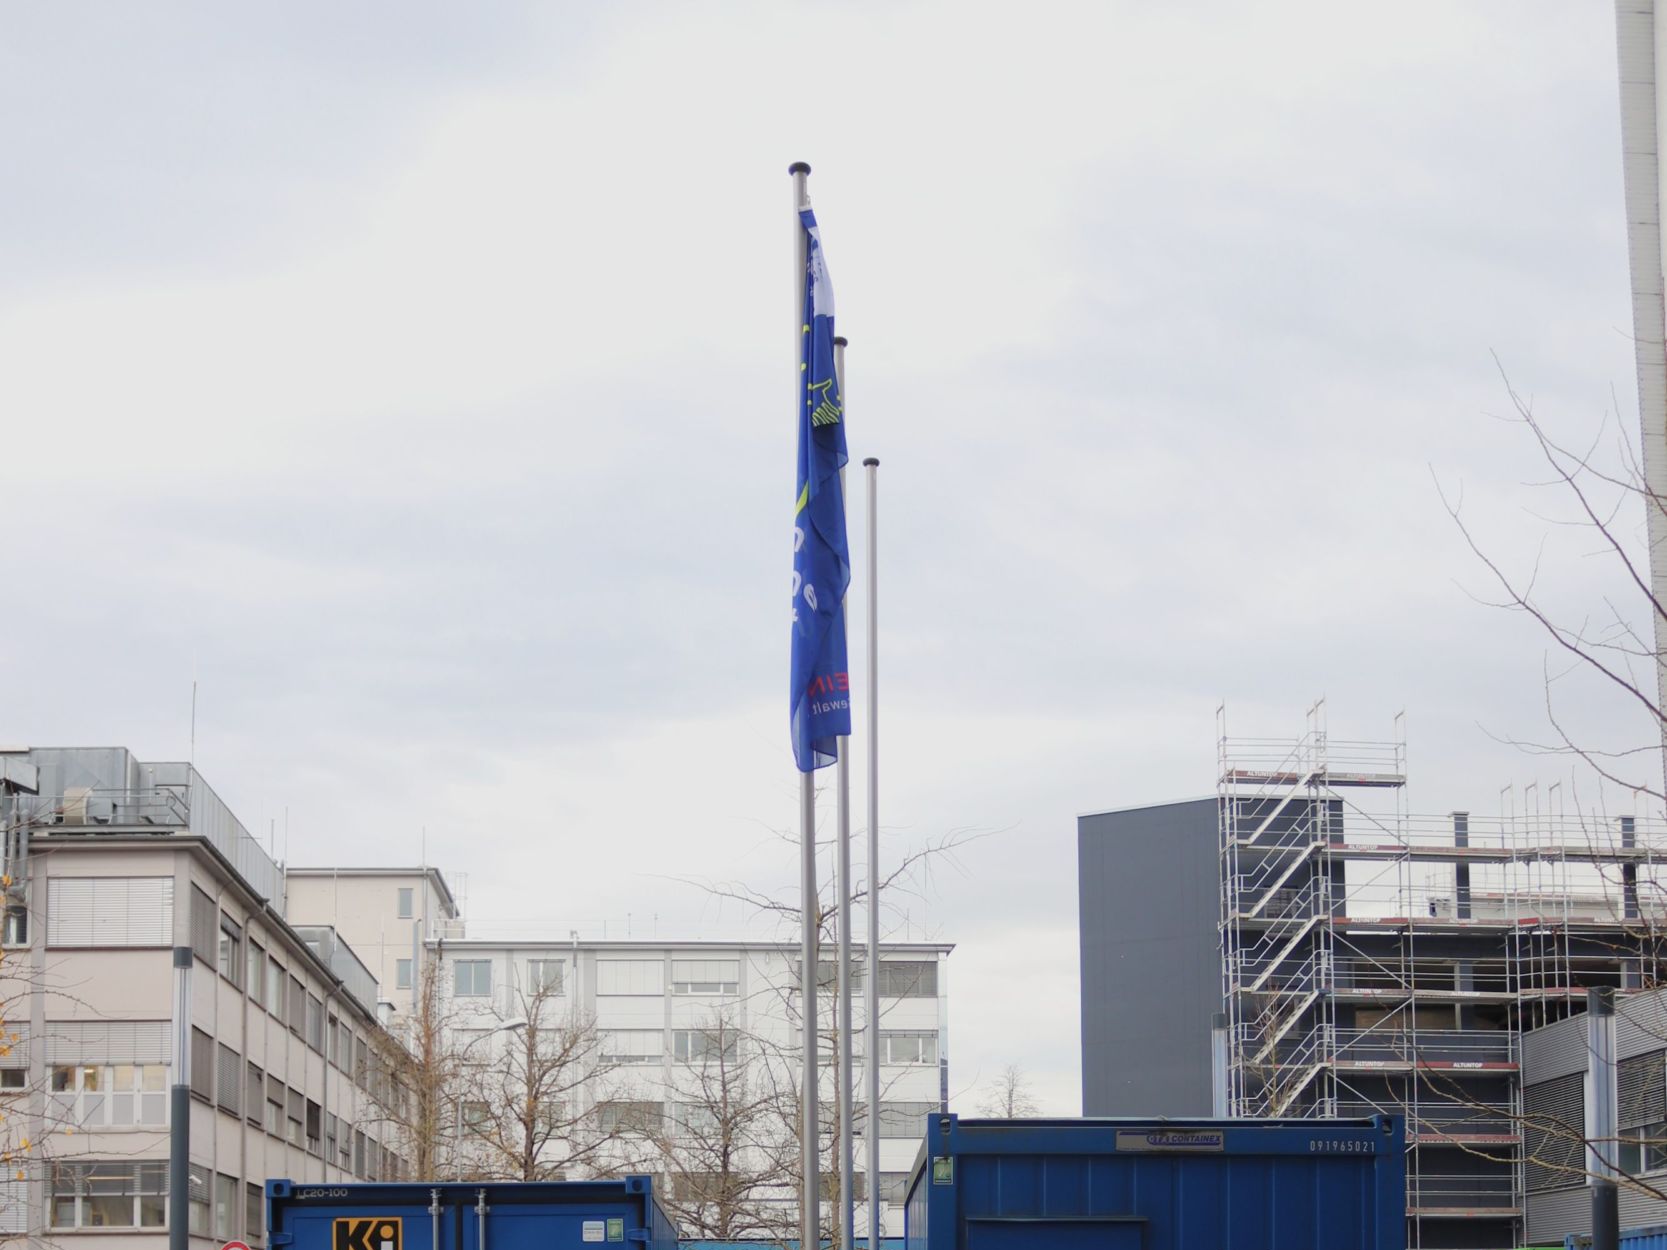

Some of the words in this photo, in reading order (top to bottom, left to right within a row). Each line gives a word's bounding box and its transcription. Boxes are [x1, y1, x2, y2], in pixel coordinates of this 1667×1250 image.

[1172, 1135, 1221, 1144] CONTAINEX
[1310, 1141, 1375, 1152] 091965021
[296, 1188, 348, 1198] LC20-100
